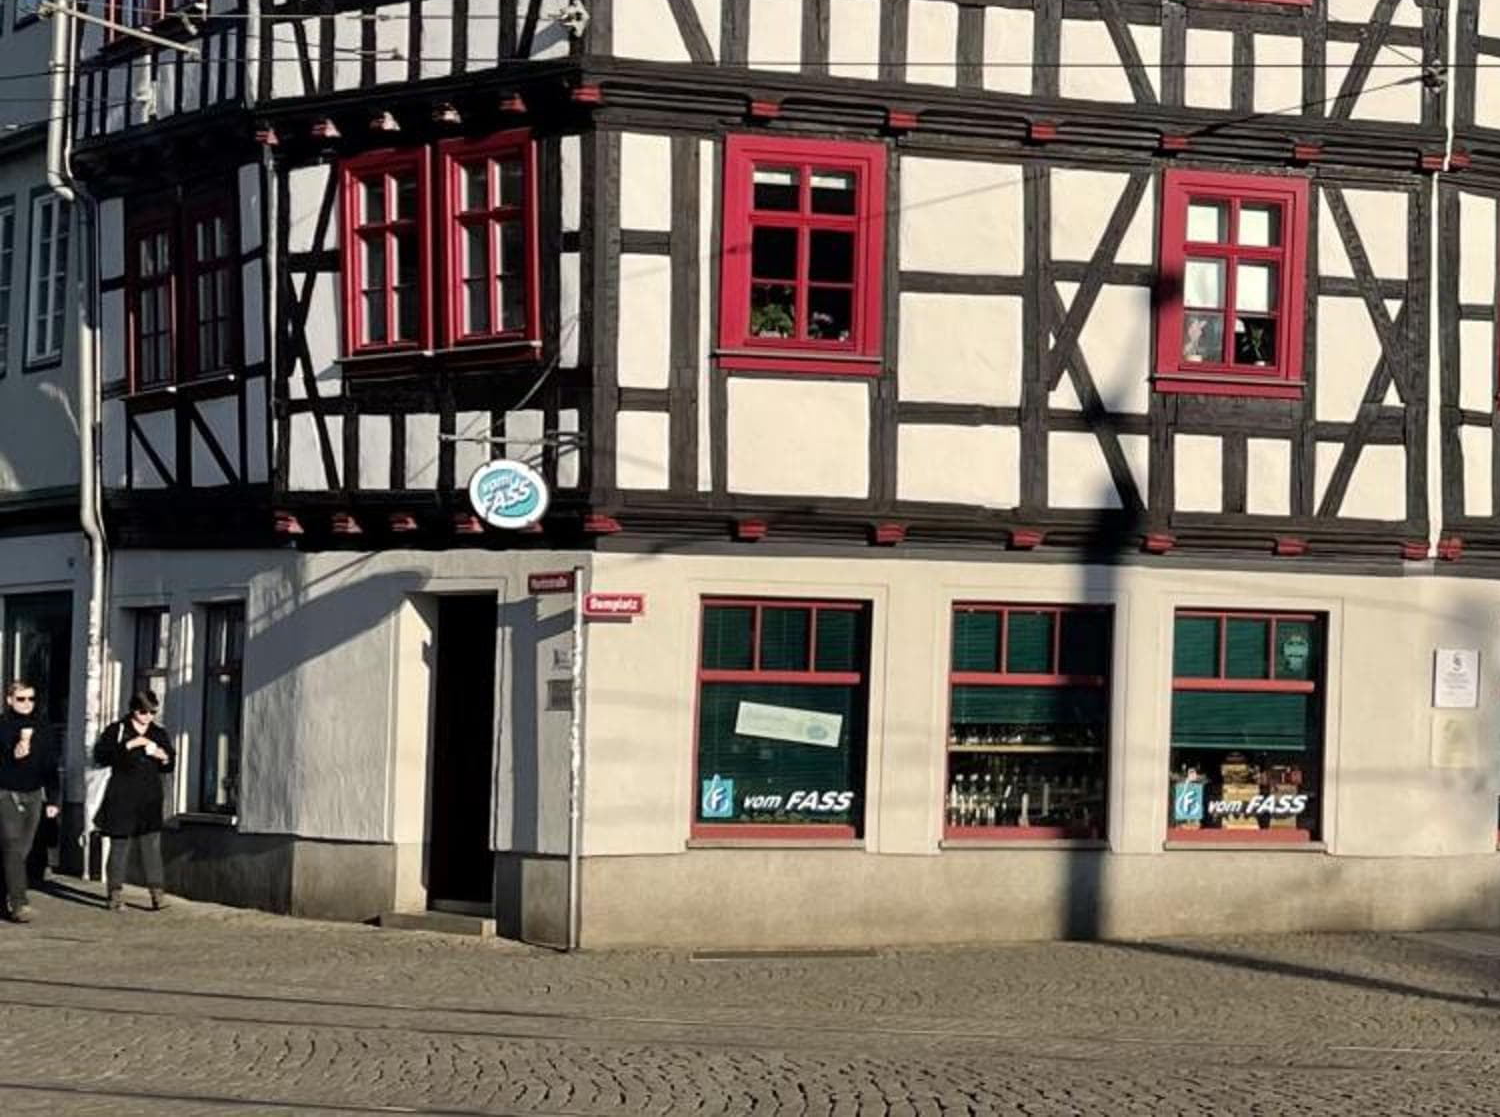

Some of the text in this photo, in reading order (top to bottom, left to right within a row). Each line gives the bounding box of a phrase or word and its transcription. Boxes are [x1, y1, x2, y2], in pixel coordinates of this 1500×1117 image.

[483, 480, 531, 516] FASS
[744, 791, 855, 812] vom FASS
[1208, 794, 1308, 814] vom FASS
